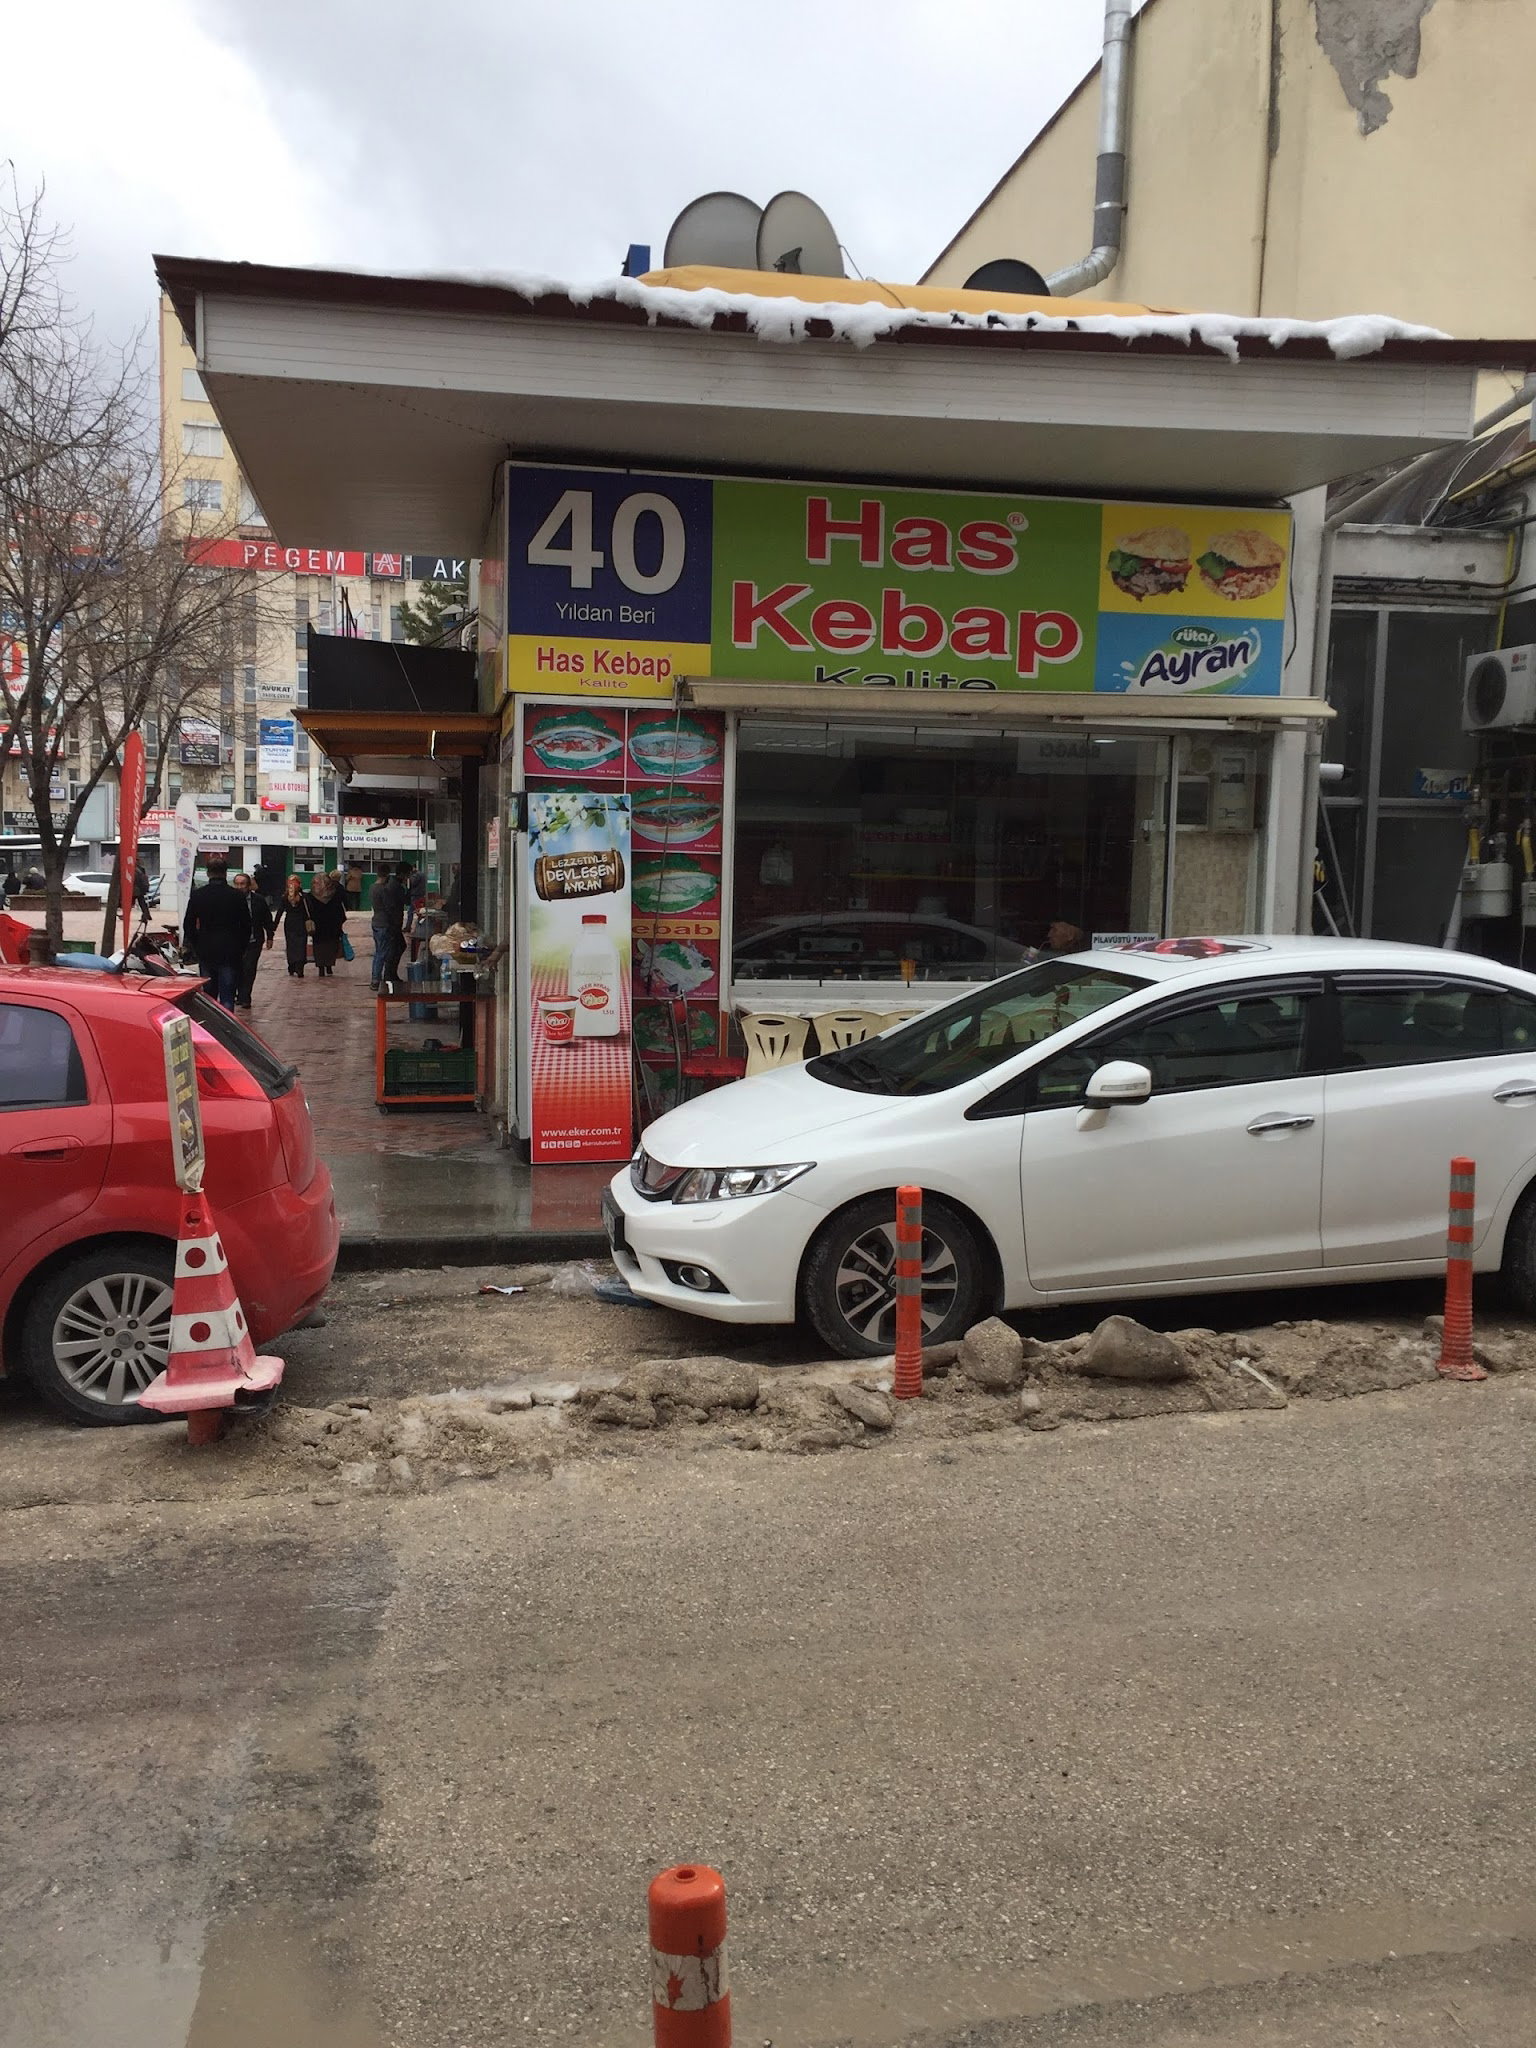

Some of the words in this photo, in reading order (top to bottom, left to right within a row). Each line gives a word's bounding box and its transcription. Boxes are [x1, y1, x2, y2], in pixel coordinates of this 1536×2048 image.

[527, 489, 686, 595] 40
[244, 545, 345, 571] PEGEM
[555, 602, 613, 622] Yıldan
[619, 605, 656, 624] Beri
[732, 580, 1083, 678] Kebap
[537, 647, 585, 673] Has
[593, 649, 671, 683] Kebap
[1140, 641, 1250, 687] Ayran
[579, 678, 629, 689] Kalite
[546, 863, 615, 882] DEVLEŞEN
[563, 880, 602, 894] AYRAN
[632, 923, 713, 935] ebab
[541, 1127, 622, 1137] www.eker.com.tr
